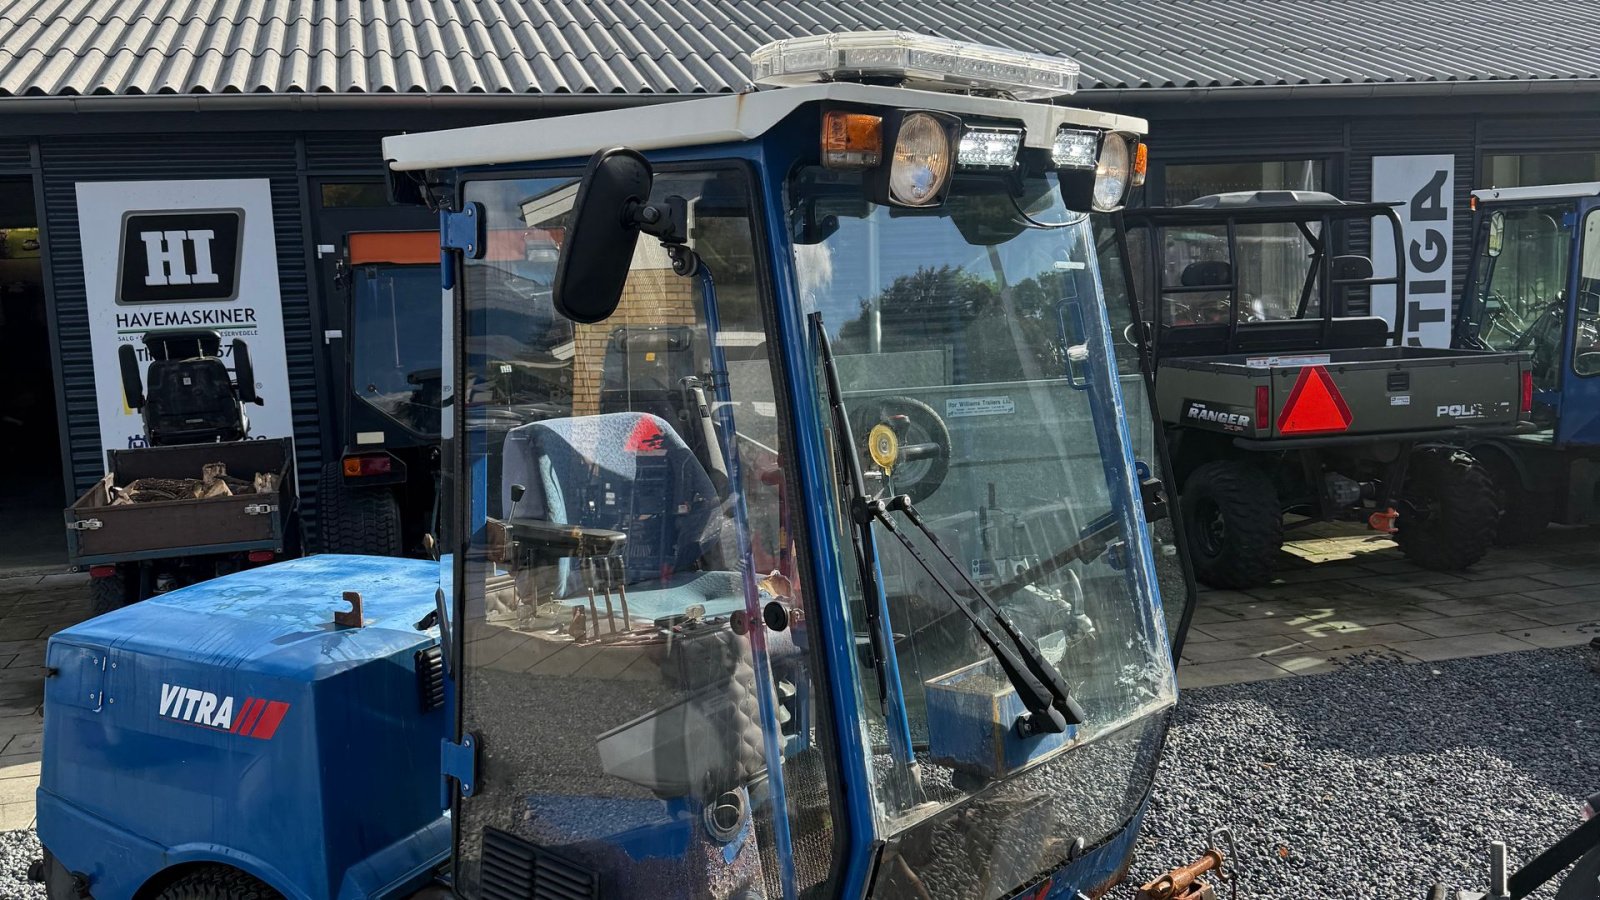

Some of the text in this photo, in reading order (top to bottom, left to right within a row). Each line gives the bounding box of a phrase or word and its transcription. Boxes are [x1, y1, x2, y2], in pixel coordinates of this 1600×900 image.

[140, 229, 219, 286] HI
[116, 308, 257, 328] HAVEMASKINER
[1188, 407, 1250, 427] RANGER
[159, 683, 234, 730] VITRA
